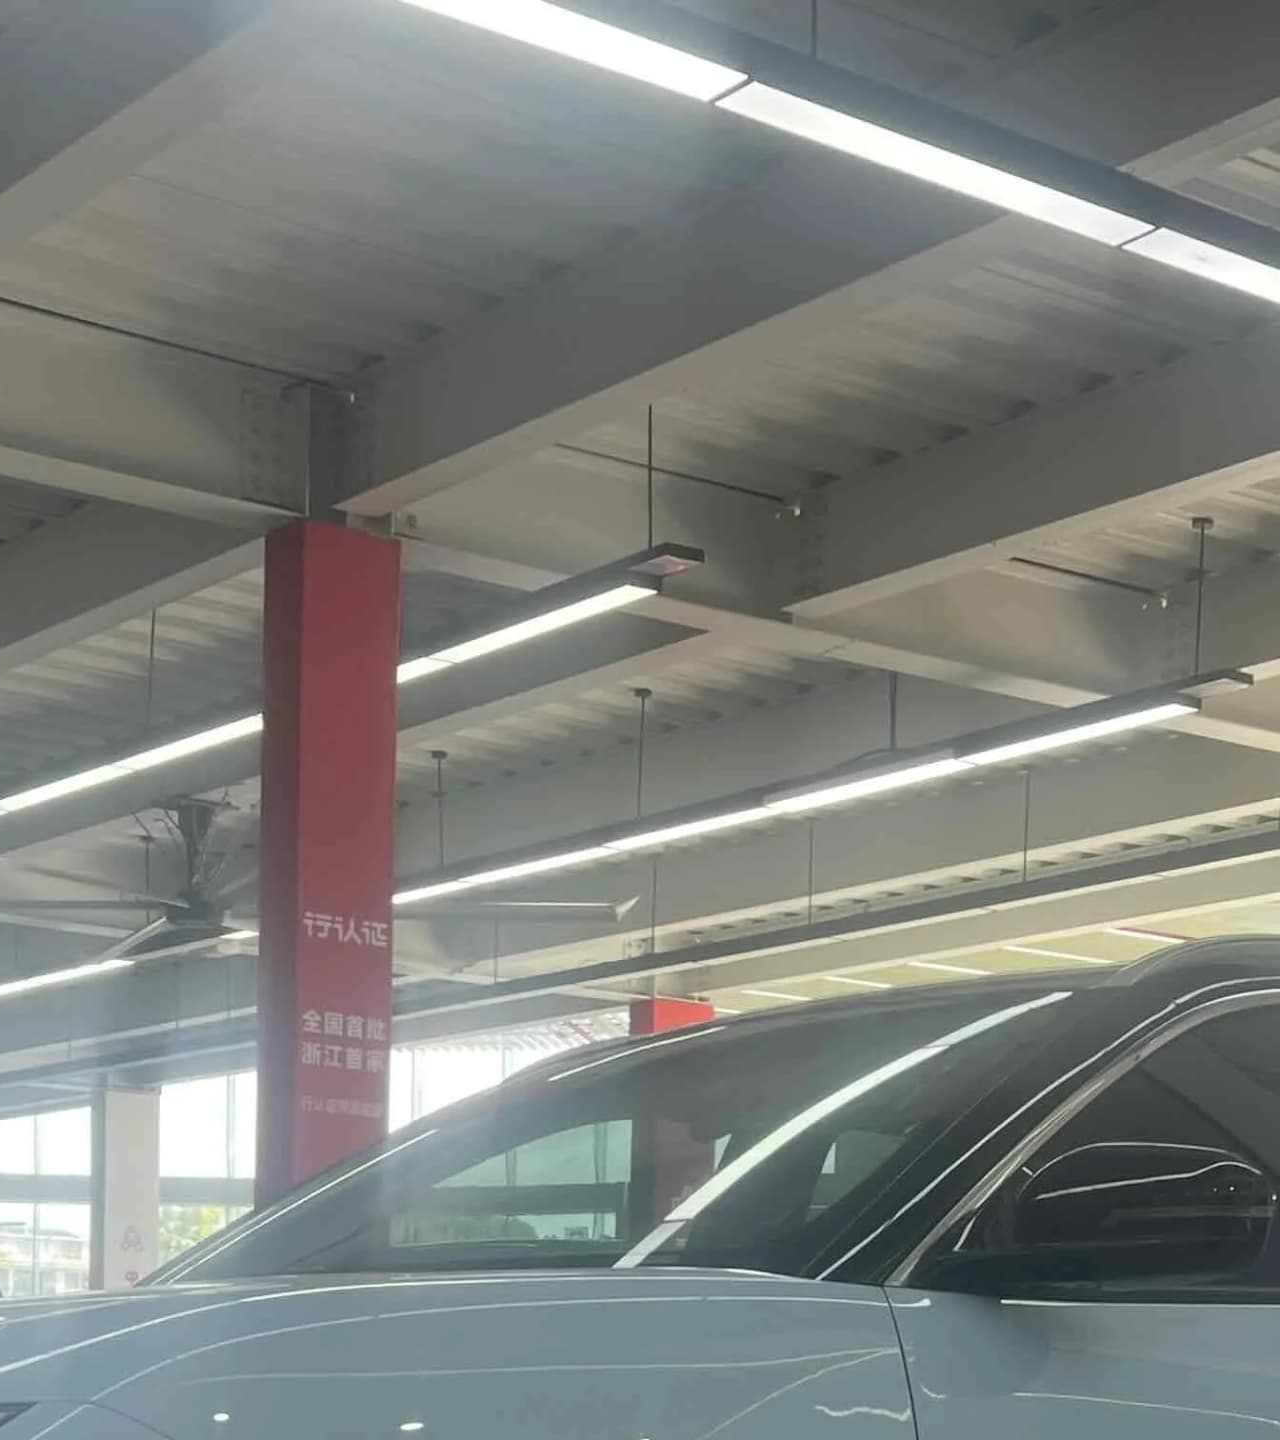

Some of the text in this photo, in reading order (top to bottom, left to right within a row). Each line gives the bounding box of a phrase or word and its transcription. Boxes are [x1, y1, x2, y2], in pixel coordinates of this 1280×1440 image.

[303, 911, 388, 947] 行认证
[302, 1010, 386, 1041] 全国首批
